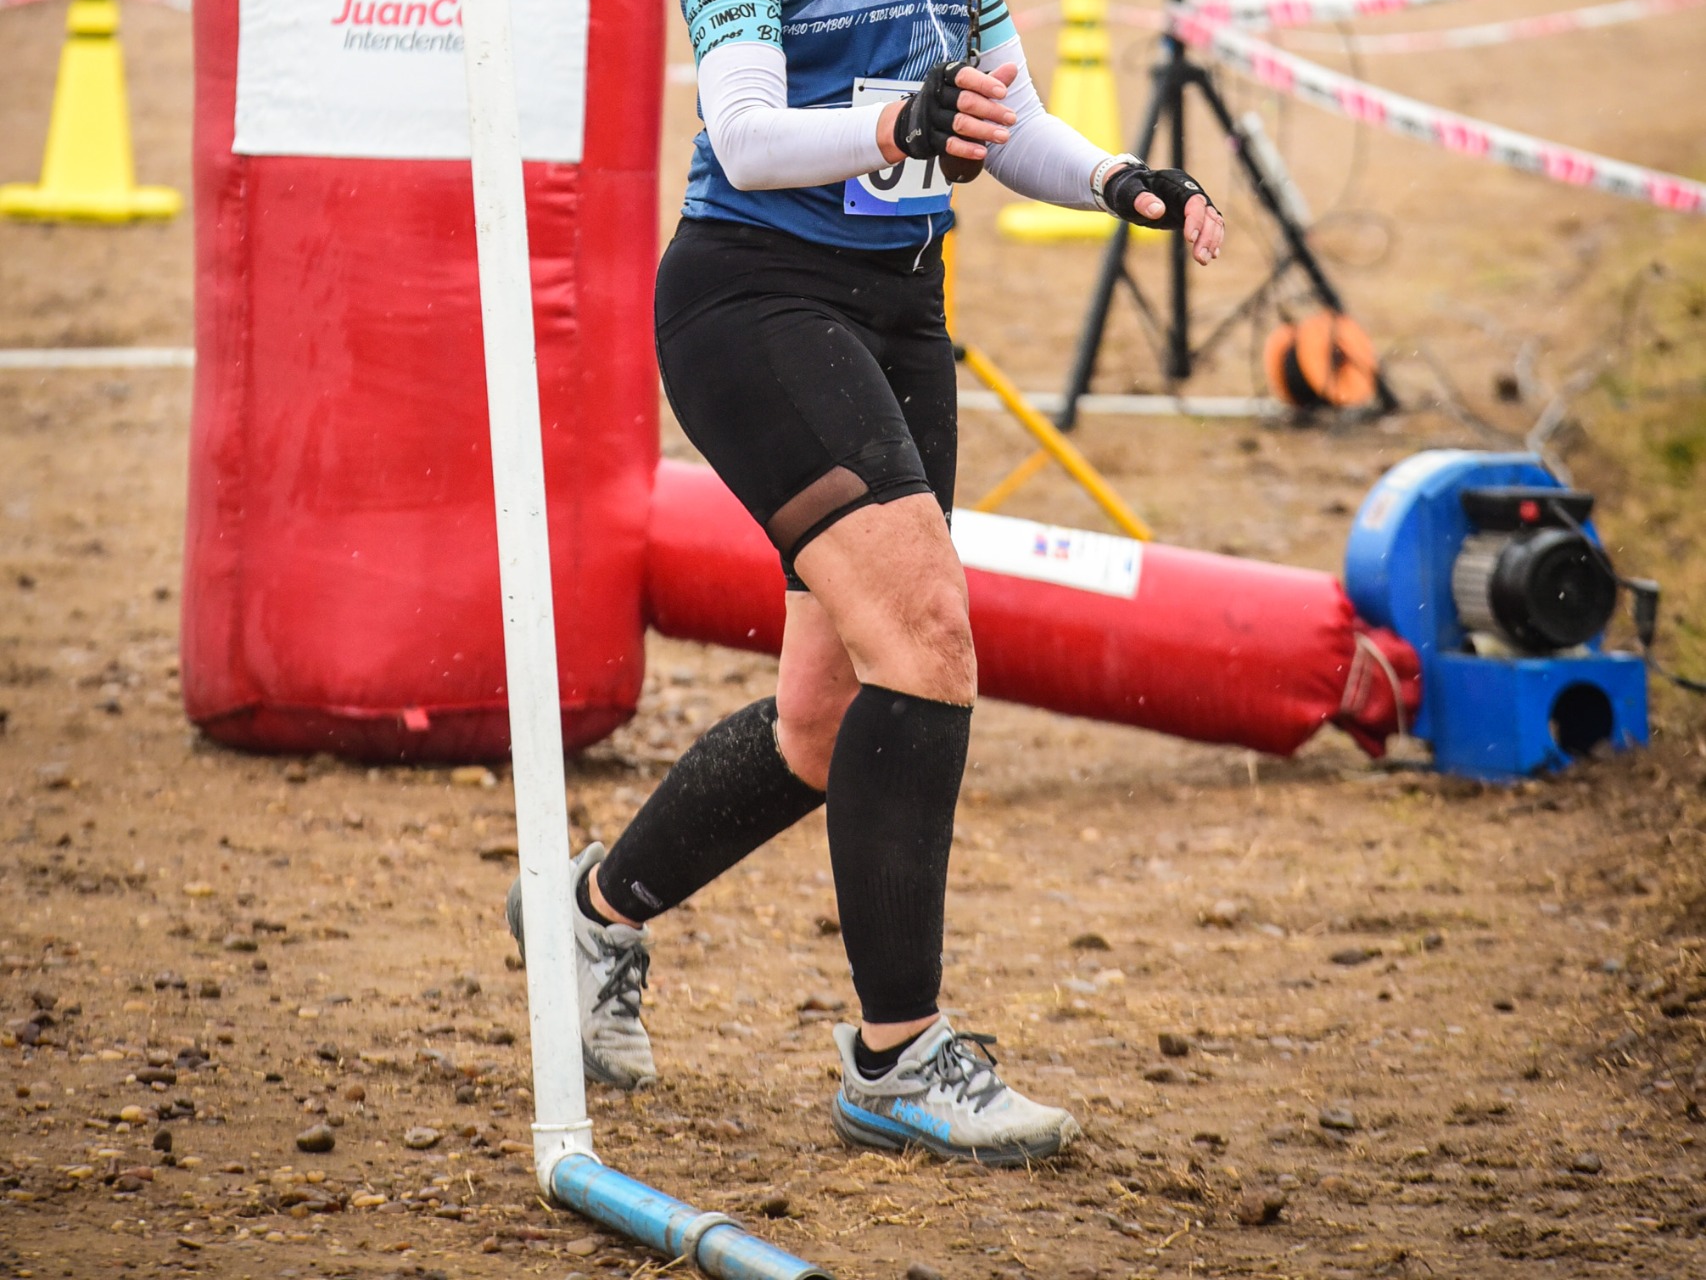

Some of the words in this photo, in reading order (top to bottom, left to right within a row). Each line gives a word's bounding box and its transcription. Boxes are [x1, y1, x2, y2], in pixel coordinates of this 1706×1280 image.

[709, 2, 757, 30] TIMBOY
[782, 23, 808, 35] PASO
[809, 15, 854, 34] TIMBOY
[891, 1097, 951, 1143] HOKA
